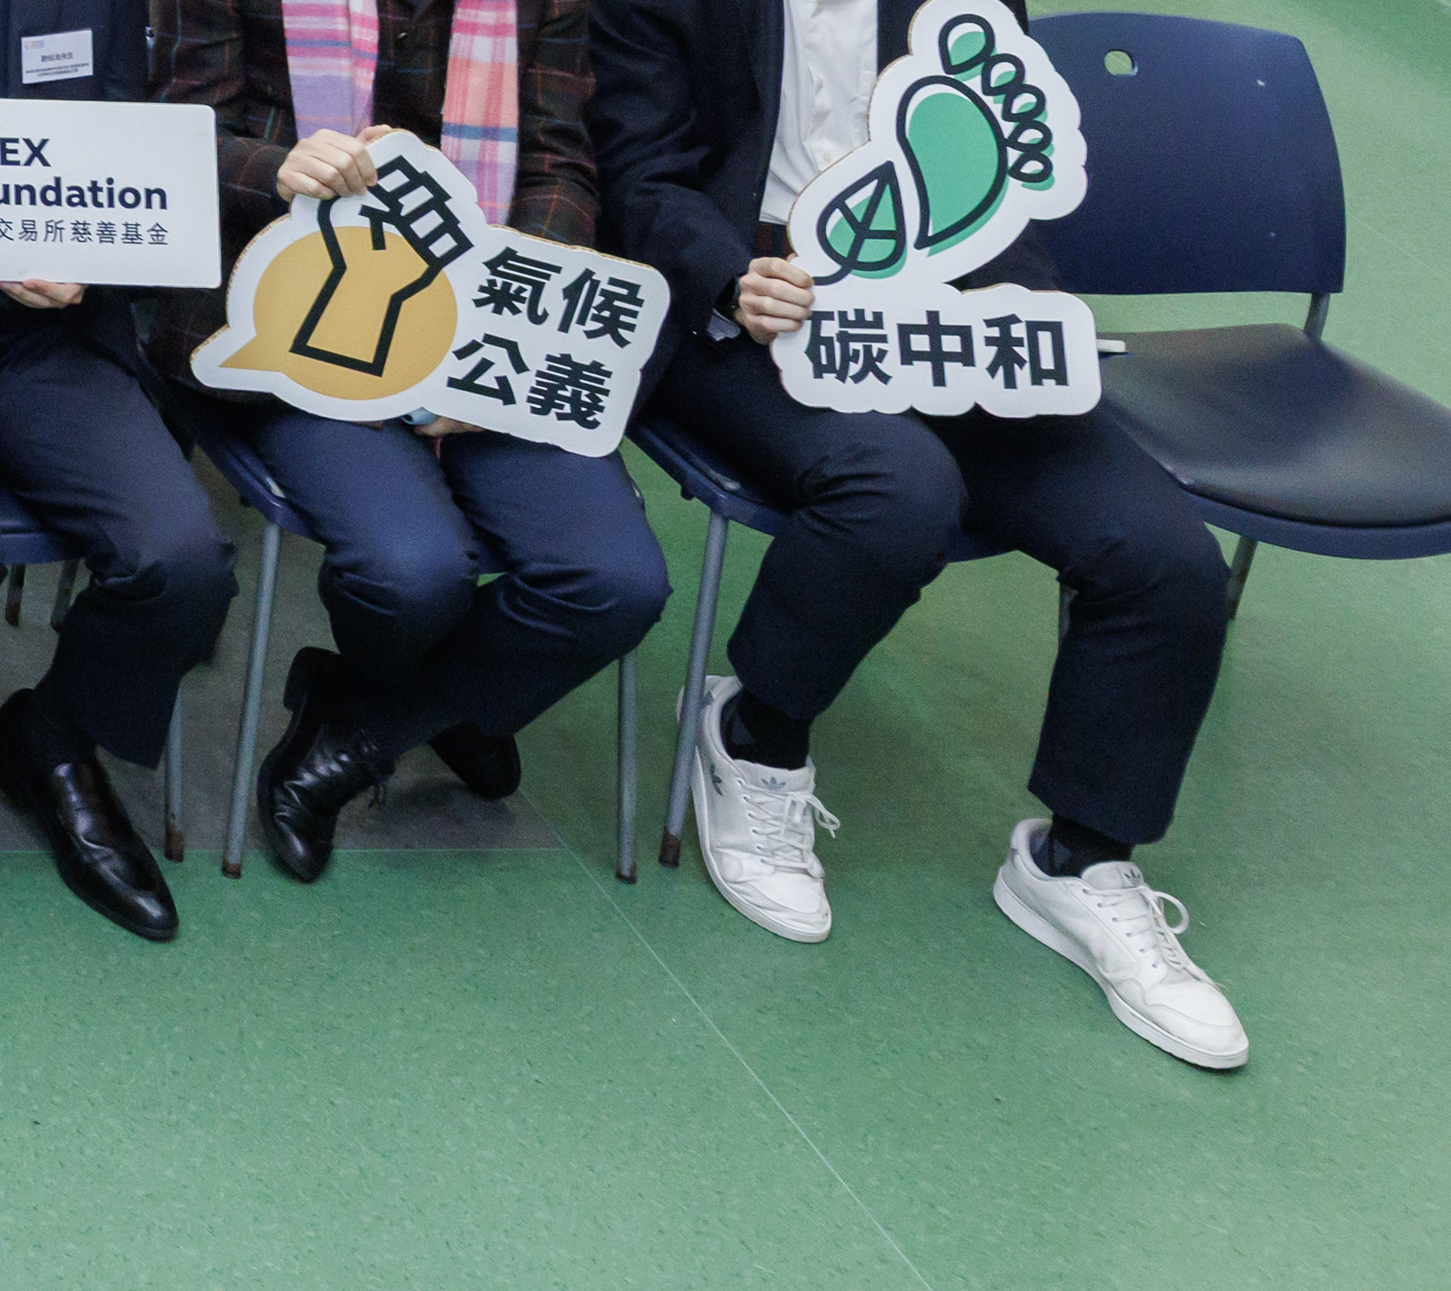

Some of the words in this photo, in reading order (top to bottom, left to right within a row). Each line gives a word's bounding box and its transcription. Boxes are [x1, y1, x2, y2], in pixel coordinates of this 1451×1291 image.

[471, 246, 645, 349] 氣候
[446, 332, 614, 430] 公義
[804, 308, 1070, 390] 碳中和
